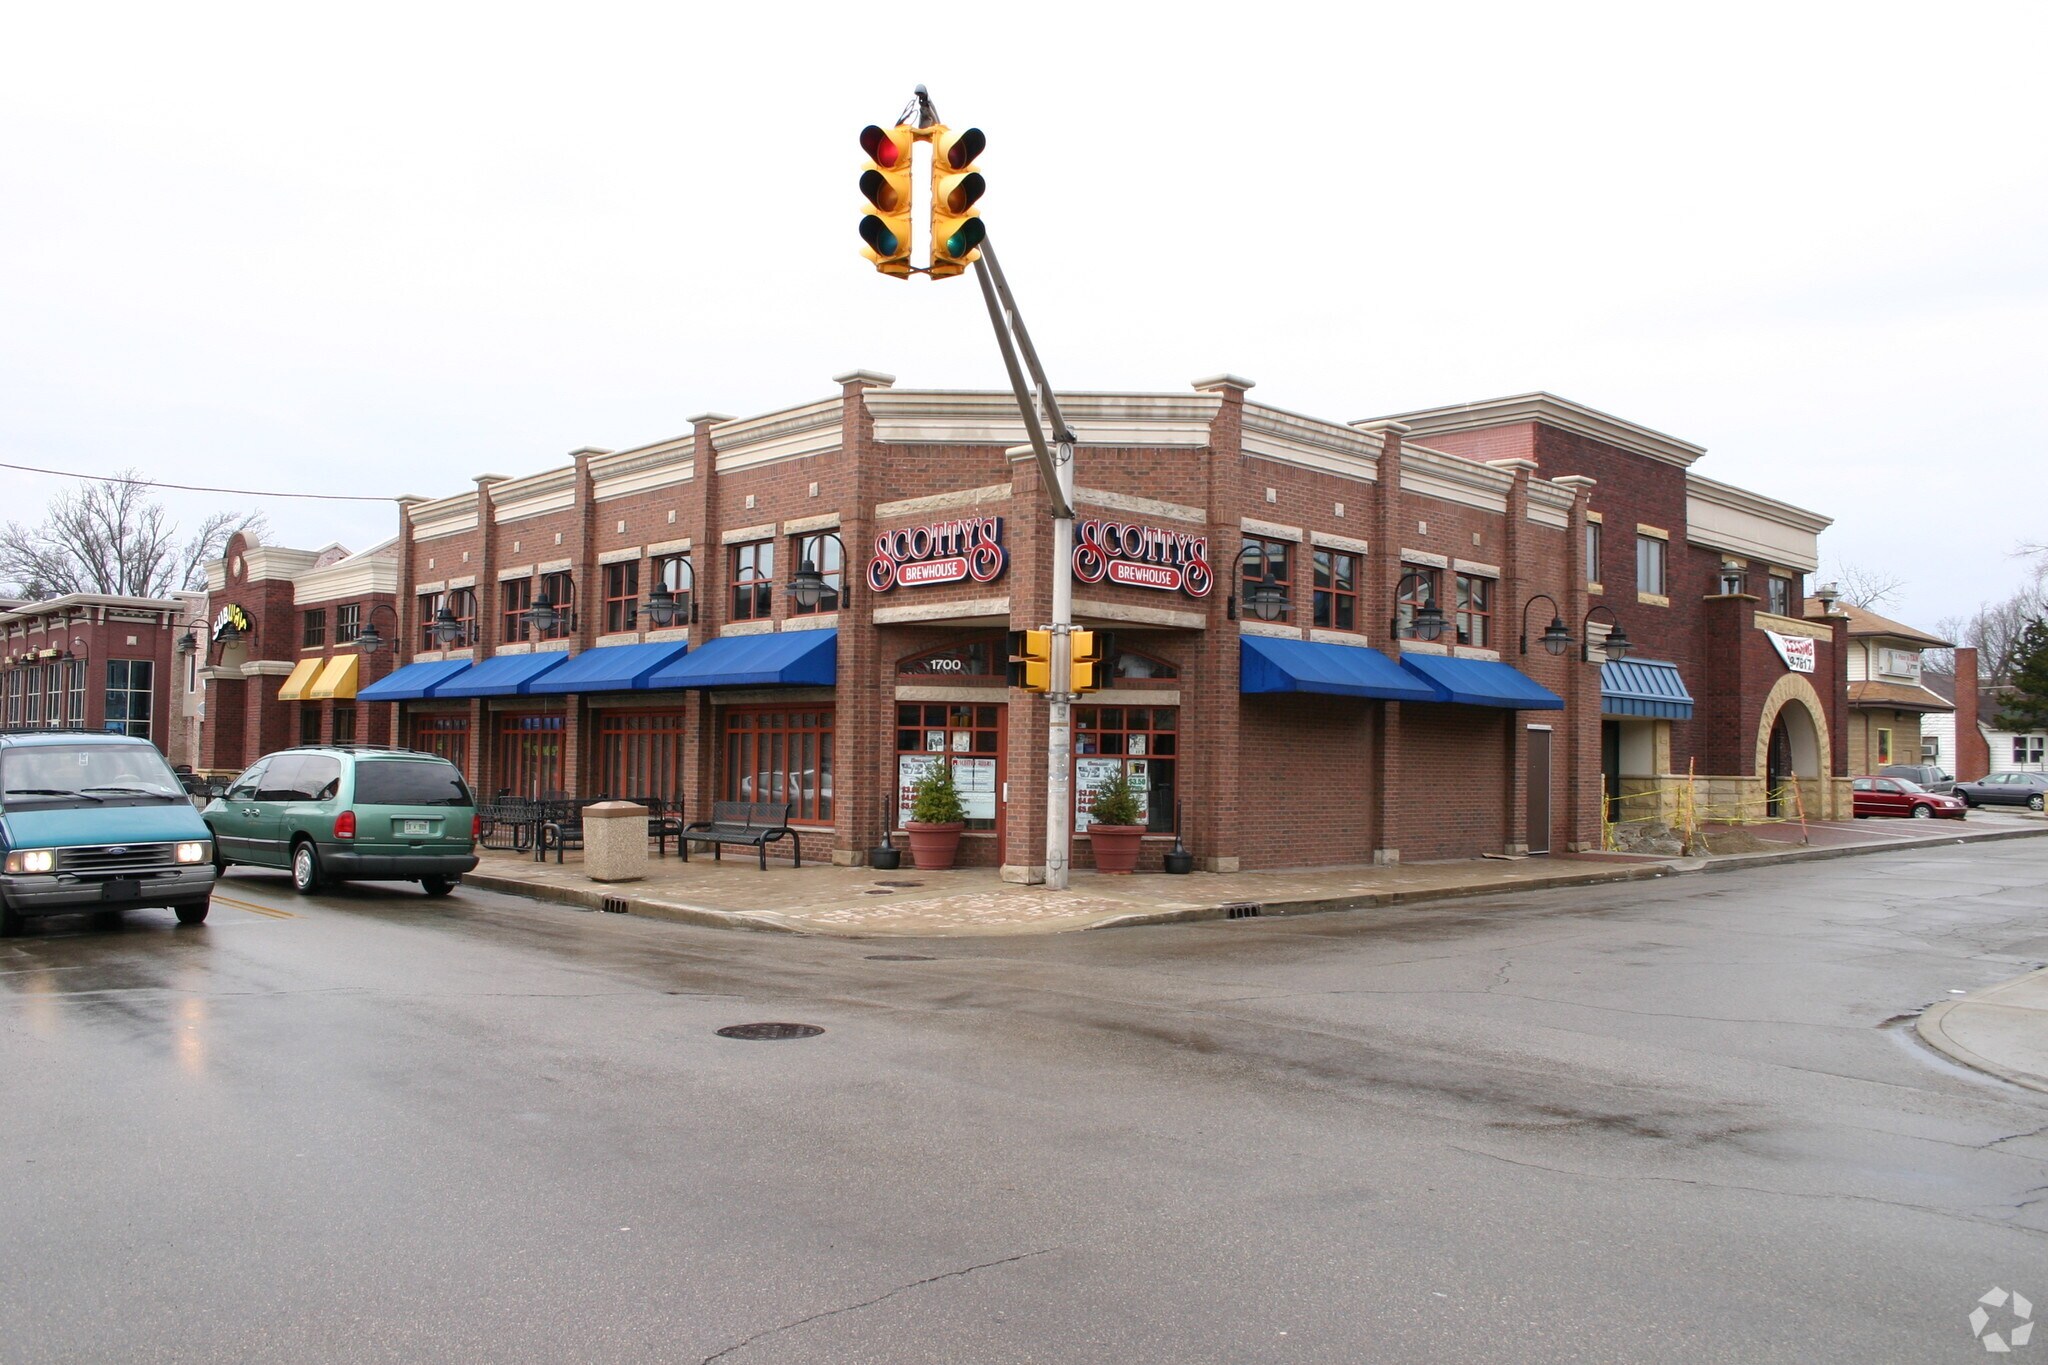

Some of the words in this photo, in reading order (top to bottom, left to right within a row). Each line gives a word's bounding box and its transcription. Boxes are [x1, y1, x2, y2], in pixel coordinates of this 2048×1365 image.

[867, 516, 1003, 592] SCOTTY'S
[1072, 519, 1214, 597] SCOTTY'S
[905, 562, 958, 581] BREWHOUSE
[1117, 566, 1172, 586] BREWHOUSE
[212, 603, 247, 640] SUBWAY
[930, 659, 961, 670] 1700
